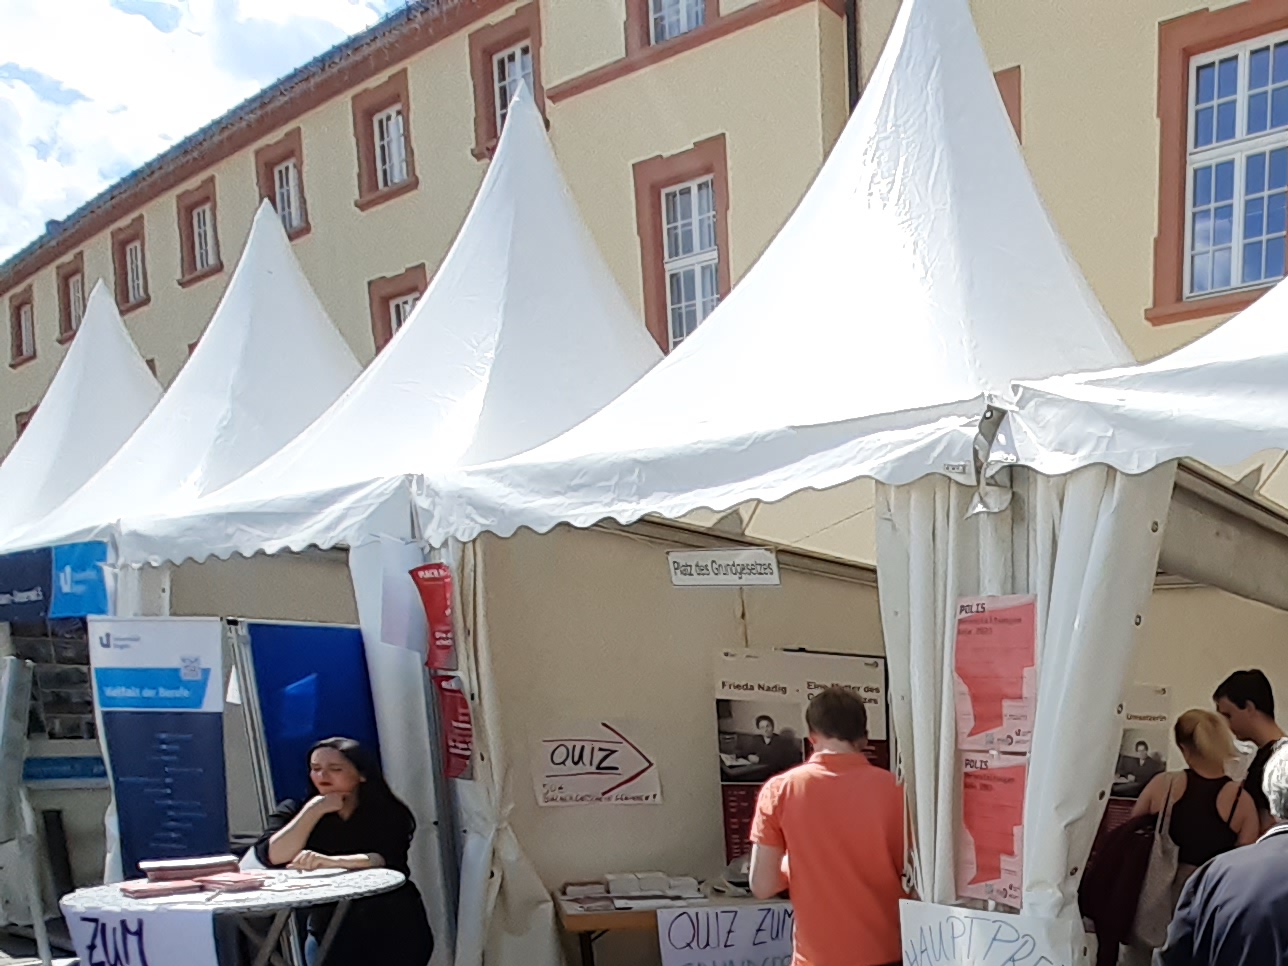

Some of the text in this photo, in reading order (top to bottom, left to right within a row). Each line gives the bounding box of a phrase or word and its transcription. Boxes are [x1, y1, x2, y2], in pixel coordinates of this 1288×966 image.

[959, 603, 985, 615] POLIS
[721, 680, 787, 695] Frieda Nadig
[668, 910, 738, 950] QUIZ
